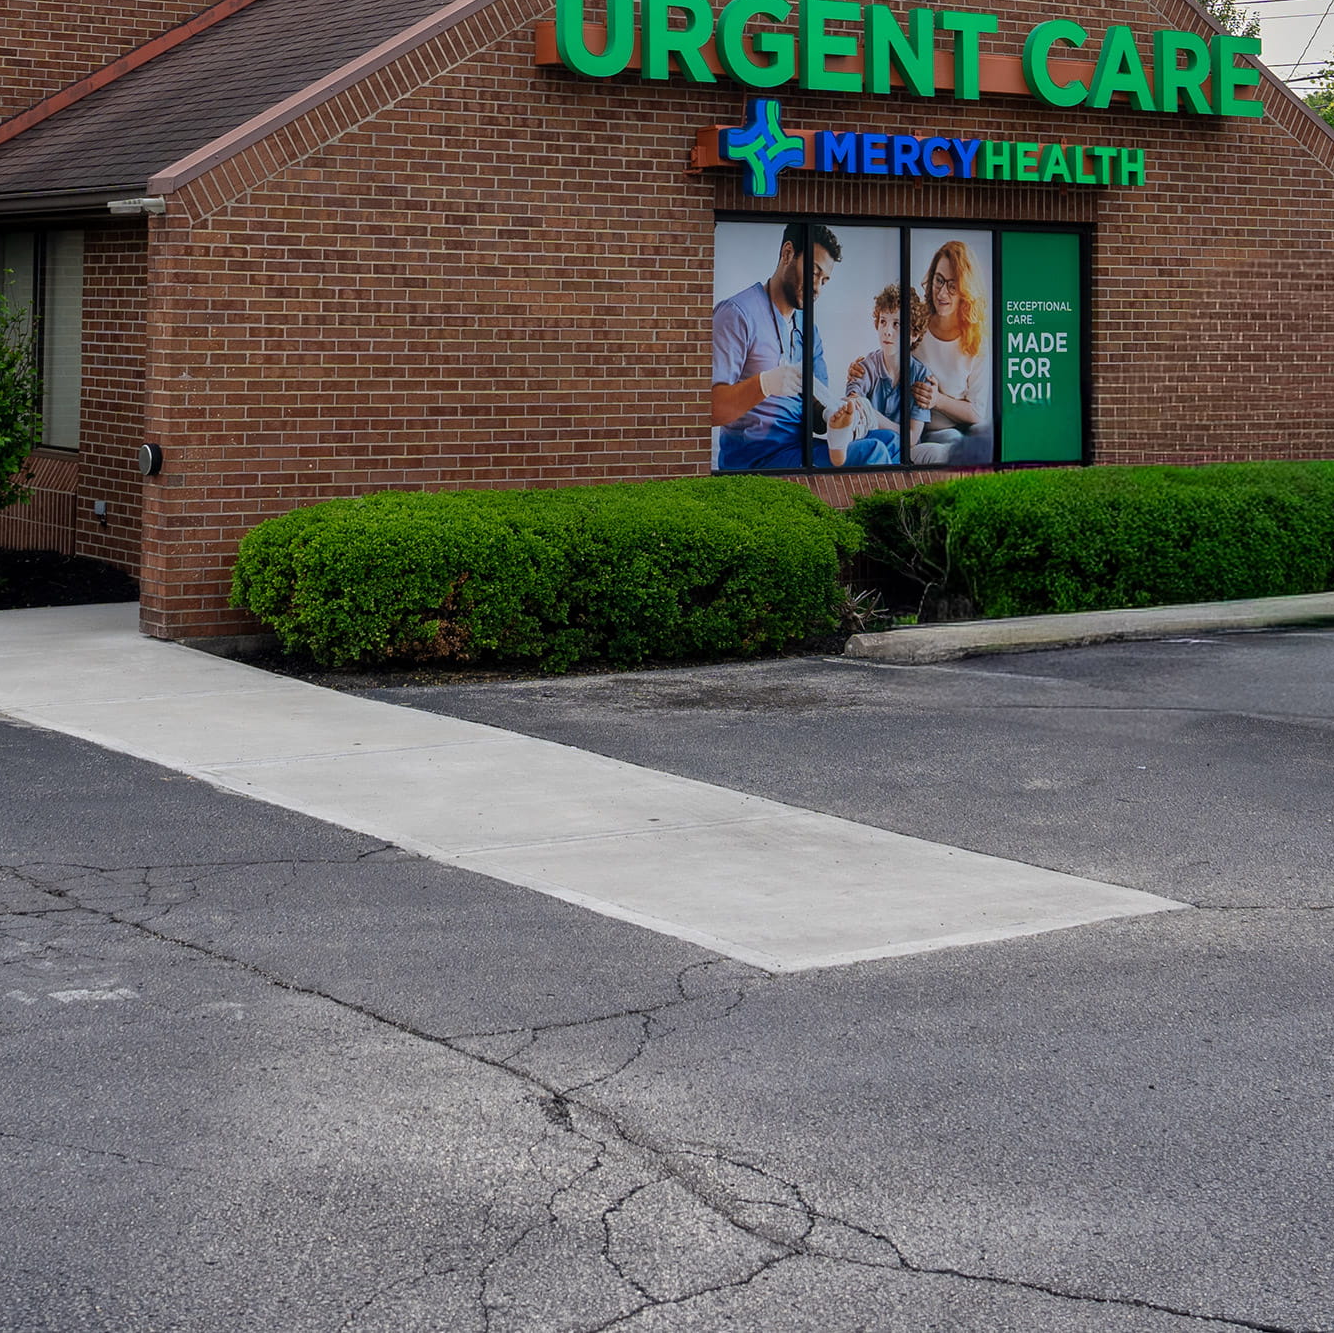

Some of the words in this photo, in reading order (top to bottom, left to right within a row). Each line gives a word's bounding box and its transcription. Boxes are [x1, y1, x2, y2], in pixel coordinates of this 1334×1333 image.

[1022, 19, 1264, 118] CARE
[1006, 301, 1072, 311] EXCEPTIONAL
[1006, 314, 1035, 324] CARE.
[1008, 332, 1068, 353] MADE
[1008, 358, 1051, 378] FOR
